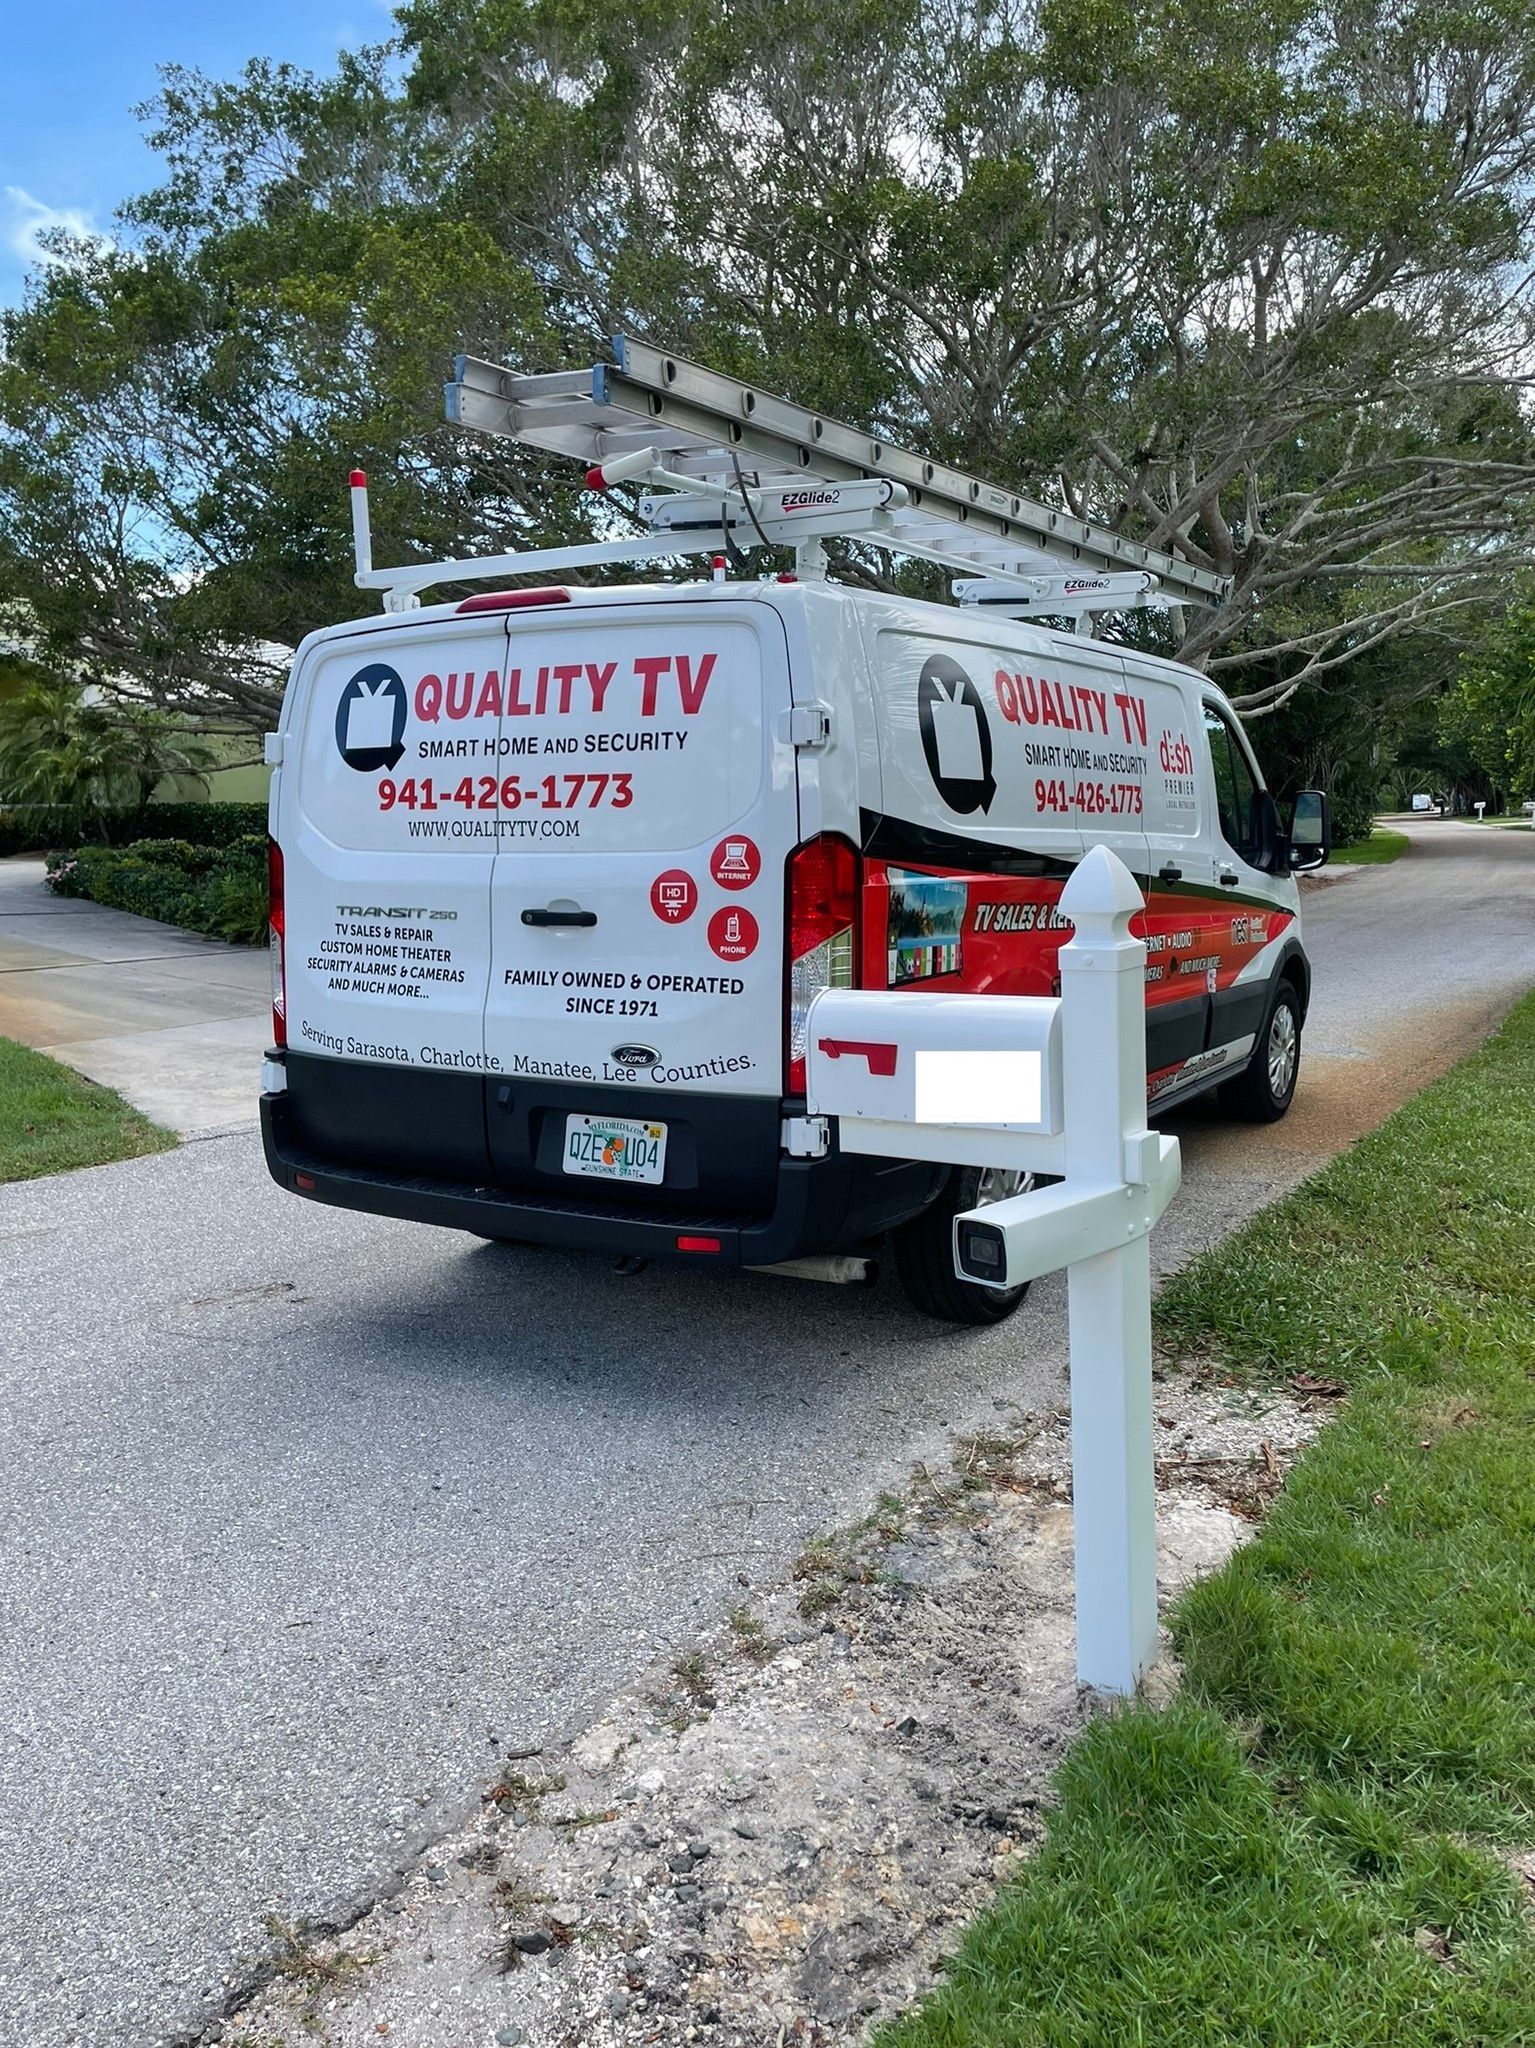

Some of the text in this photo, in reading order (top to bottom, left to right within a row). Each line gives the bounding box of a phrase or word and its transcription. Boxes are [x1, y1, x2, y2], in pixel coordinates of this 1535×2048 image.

[781, 489, 840, 506] EZGlide2
[1064, 578, 1110, 589] EZGlide2
[414, 653, 718, 724] QUALITY TV
[995, 669, 1148, 747] QUALITY TV
[418, 730, 688, 758] SMART HOME AND SECURITY
[1160, 729, 1194, 775] dish
[1024, 743, 1148, 775] SMART HOME AND SECURITY
[378, 773, 634, 812] 941-426-1773
[1034, 778, 1143, 814] 941-426-1773
[1164, 779, 1194, 796] PREMIER
[408, 820, 580, 841] WWW.QUALITYTV.COM
[717, 872, 752, 880] INTERNET
[666, 888, 681, 898] HD
[336, 906, 457, 920] TRANSIT 250
[667, 909, 679, 917] TV
[974, 904, 996, 931] TV
[993, 904, 1037, 931] SALES
[1036, 904, 1048, 929] &
[335, 923, 433, 942] TV SALES & REPAIR
[1172, 931, 1193, 950] AUDIO
[320, 940, 452, 963] CUSTOM HOME THEATER
[720, 946, 747, 954] PHONE
[307, 957, 465, 983] SECURITY ALARMS & CAMERAS
[328, 977, 429, 999] AND MUCH MORE...
[504, 969, 744, 995] FAMILY OWNED & OPERATED
[565, 997, 659, 1017] SINCE 1971
[301, 1020, 756, 1084] Serving Sarasota, Charlotte, Manatee, Lee Counties.
[620, 1048, 648, 1063] Ford
[570, 1131, 603, 1163] QZE
[584, 1164, 640, 1178] SUNSHINE STATE
